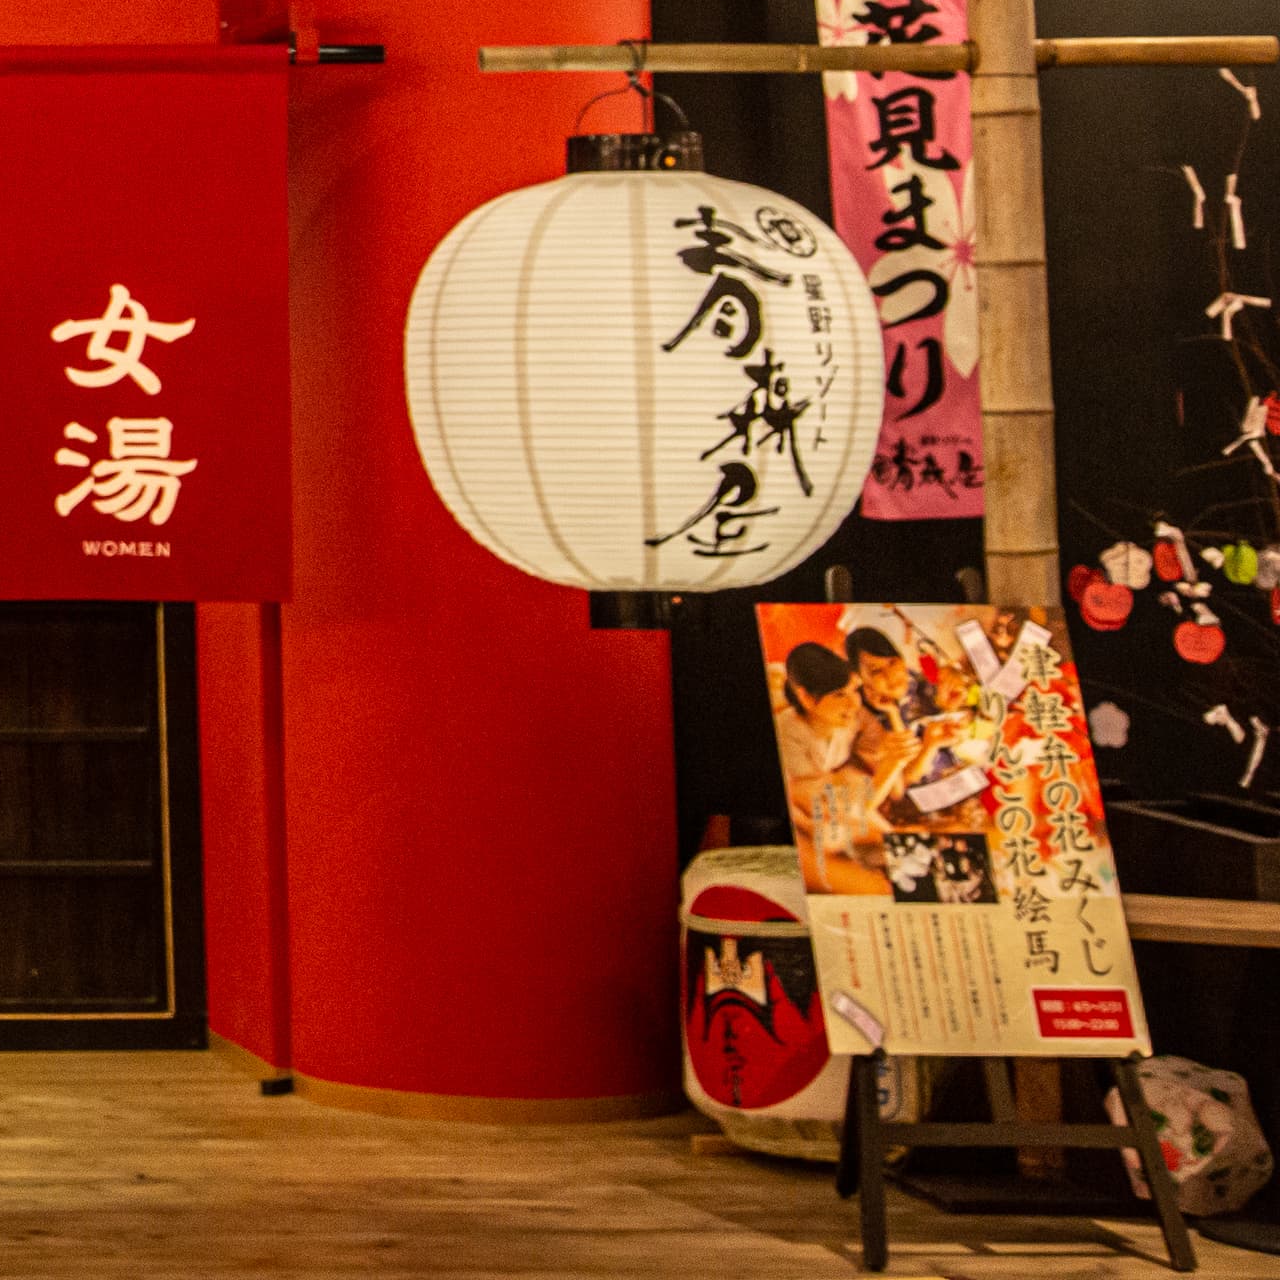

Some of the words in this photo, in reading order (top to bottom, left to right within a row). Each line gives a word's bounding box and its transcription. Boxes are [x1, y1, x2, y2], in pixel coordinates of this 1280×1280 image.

[50, 283, 198, 525] 女湯
[645, 205, 813, 558] 青森屋
[82, 540, 171, 558] WOMEN
[979, 690, 1061, 975] りんごの花絵馬
[1020, 642, 1114, 978] 津軽弁の花みくじ
